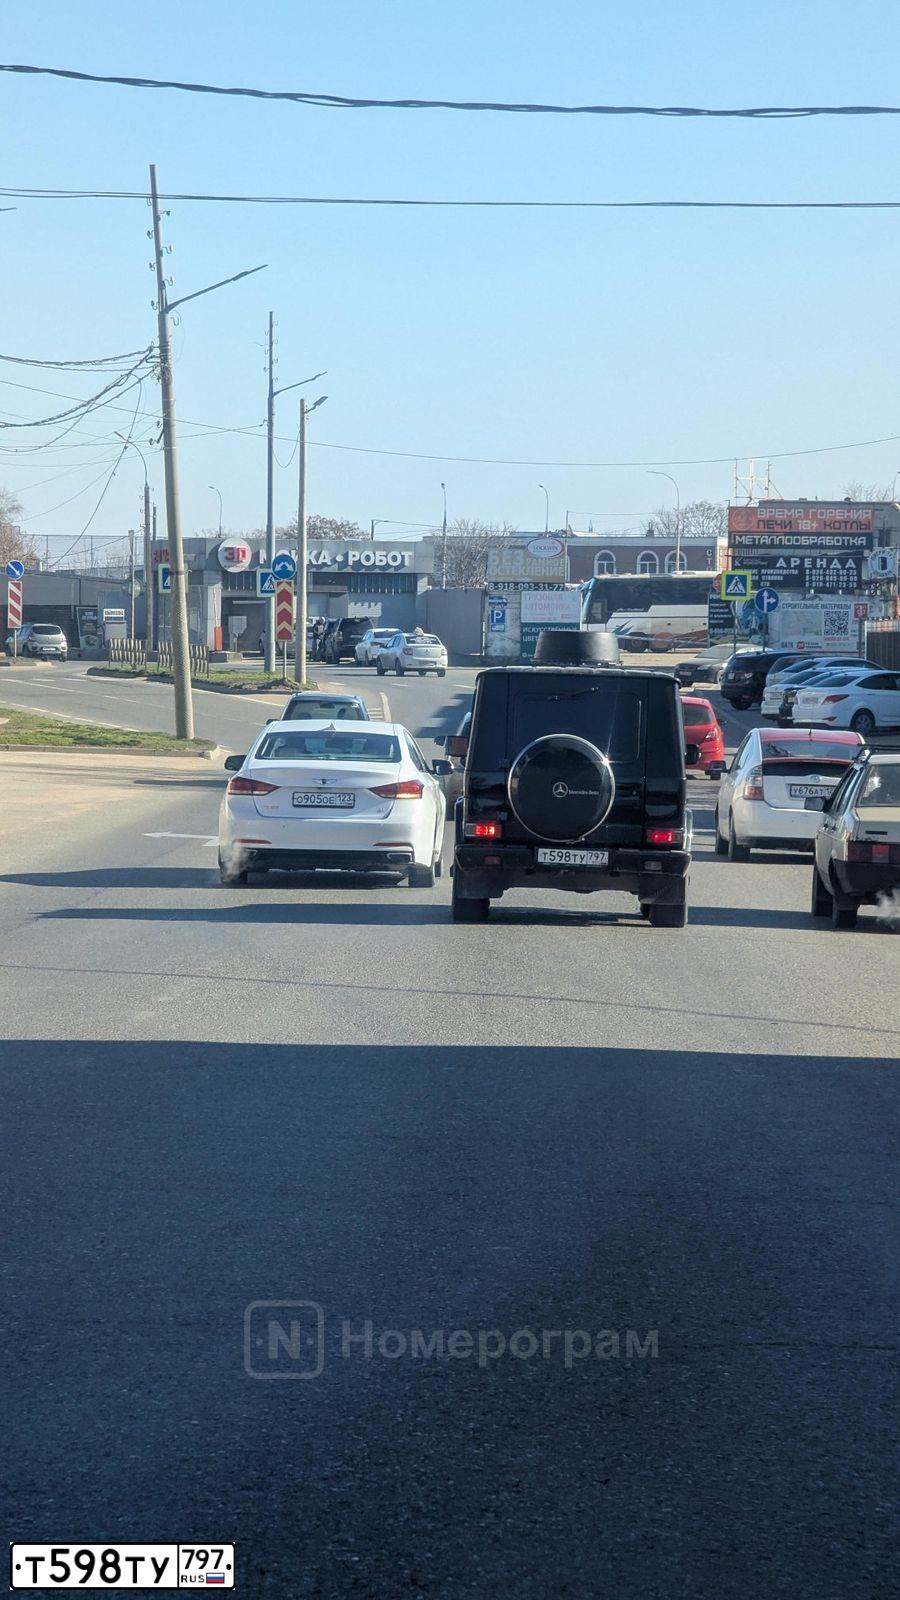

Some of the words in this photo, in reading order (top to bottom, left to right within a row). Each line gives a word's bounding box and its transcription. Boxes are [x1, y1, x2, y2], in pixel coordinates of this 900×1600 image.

[757, 508, 804, 519] ВРЕМЯ
[809, 509, 872, 520] ГОРЕНИЯ
[757, 520, 792, 529] ПЕЧИ
[799, 520, 818, 529] 18+
[823, 520, 871, 530] КОТЛЫ
[735, 535, 866, 546] МЕТАЛЛООБРАБОТКА
[347, 550, 413, 567] РОБОТ
[776, 558, 857, 569] АРЕНДА
[489, 566, 565, 577] ОСТЕКЛЕНИЕ
[296, 794, 335, 804] О905ОЕ
[338, 794, 352, 803] 123
[542, 850, 586, 863] Т598ТУ
[588, 852, 606, 862] 797
